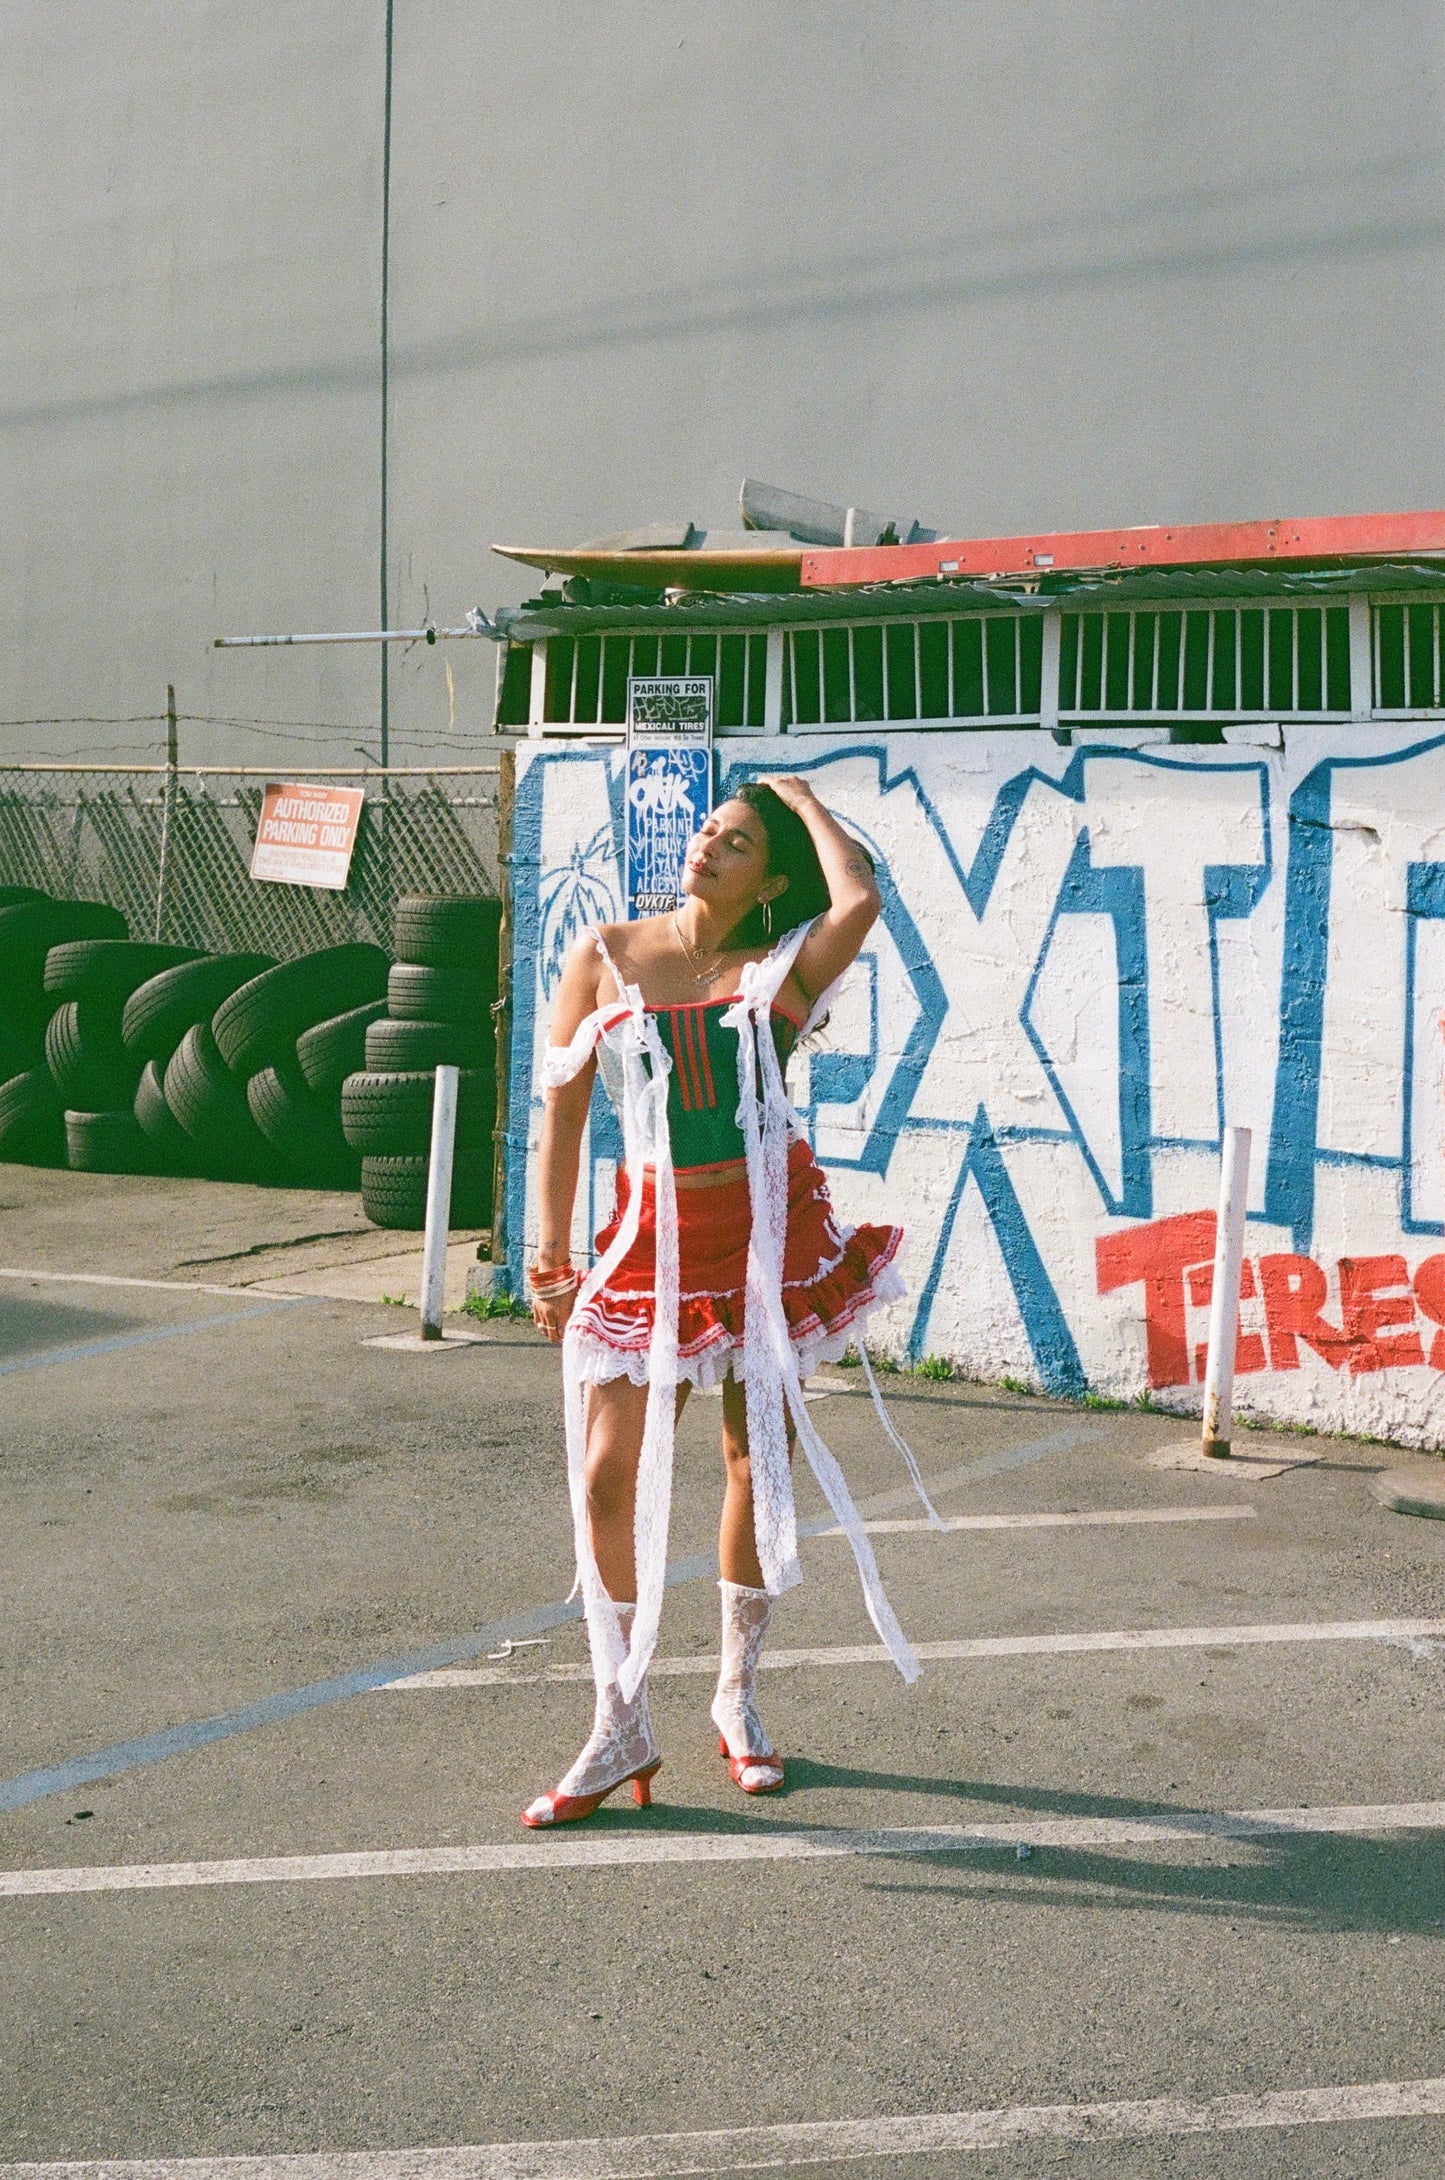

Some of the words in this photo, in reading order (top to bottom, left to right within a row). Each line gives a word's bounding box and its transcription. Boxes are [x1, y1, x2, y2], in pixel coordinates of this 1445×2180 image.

[633, 683, 680, 695] PARKING
[684, 683, 706, 694] FOR
[634, 721, 676, 732] MEXICALI
[679, 721, 705, 731] TIRES
[272, 797, 350, 825] AUTHORIZED
[262, 818, 319, 845] PARKING
[319, 825, 351, 849] ONLY
